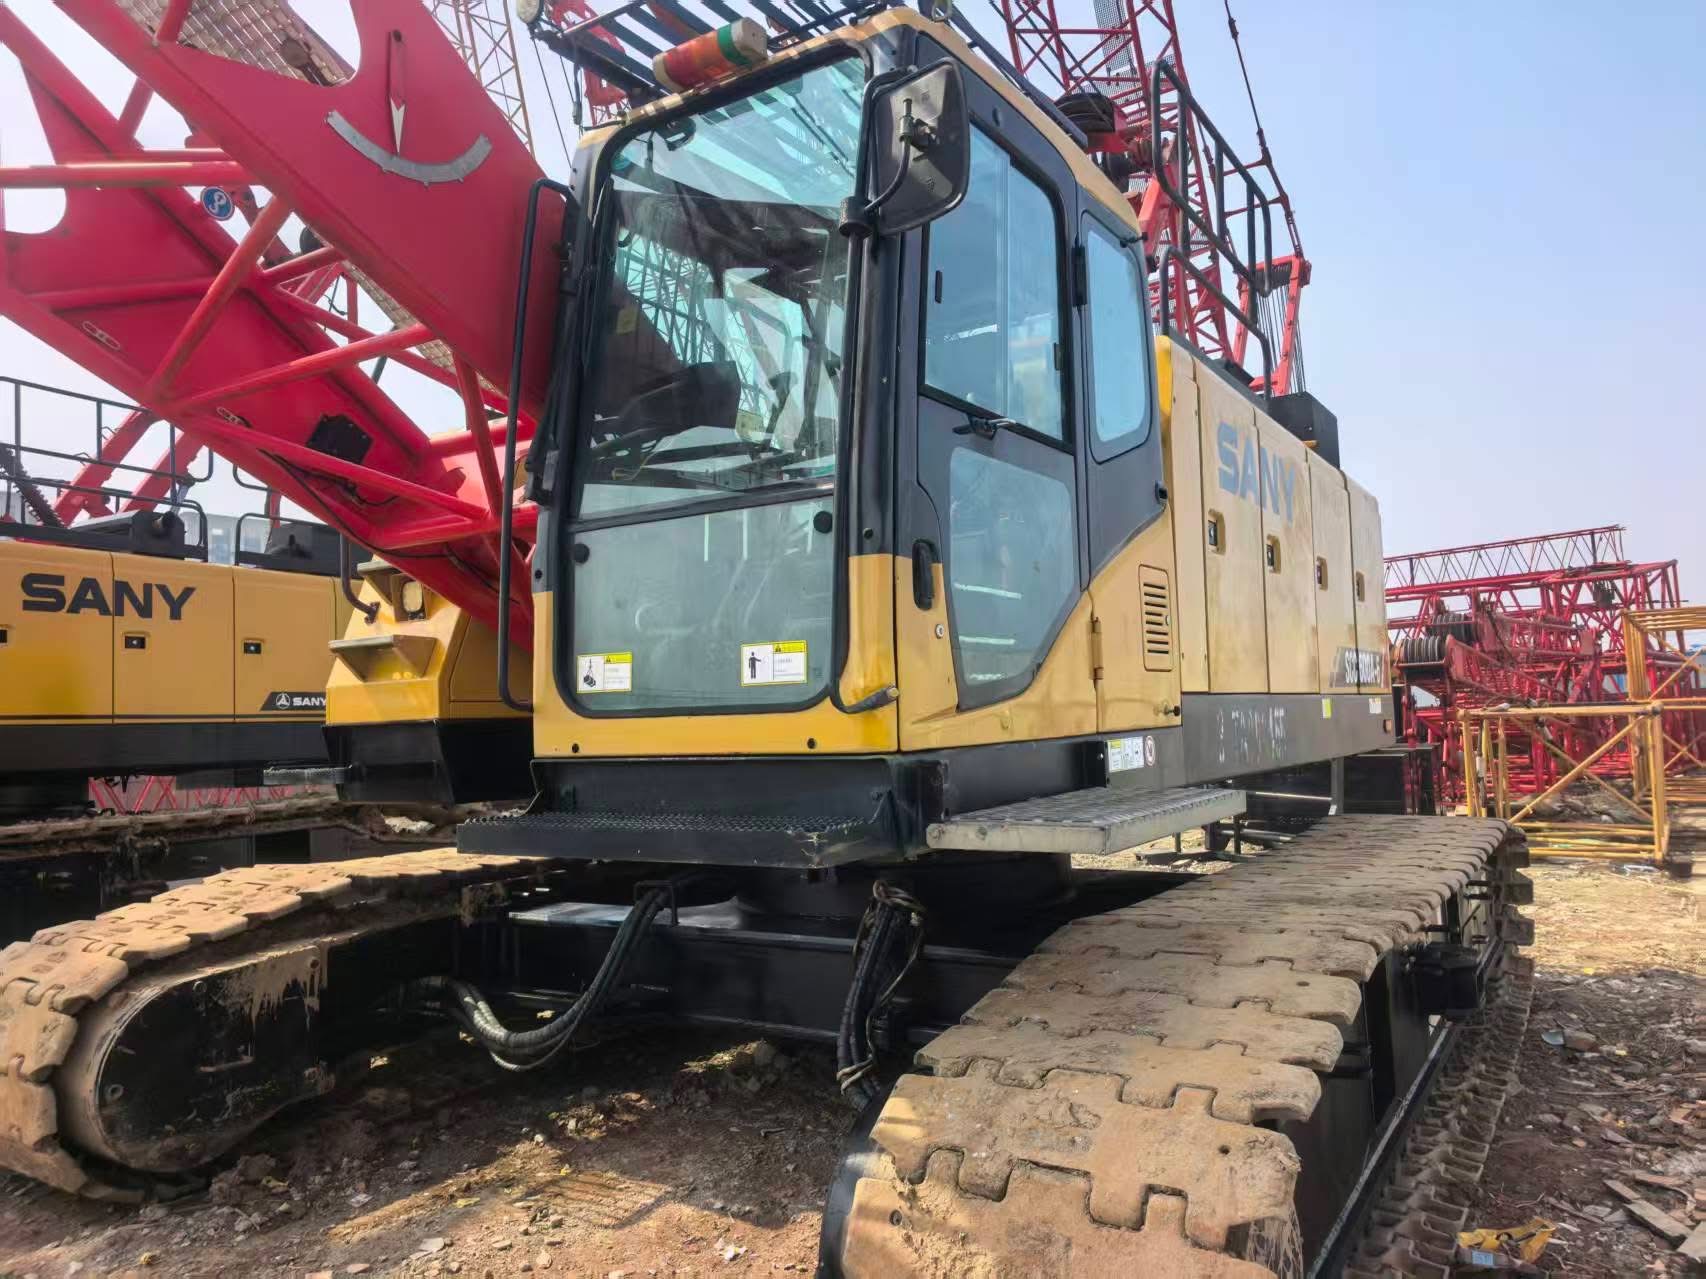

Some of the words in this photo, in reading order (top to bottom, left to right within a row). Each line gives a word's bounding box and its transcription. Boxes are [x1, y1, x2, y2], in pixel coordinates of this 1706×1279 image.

[1217, 421, 1295, 527] SANY
[21, 573, 196, 620] SANY
[292, 696, 326, 706] SANY
